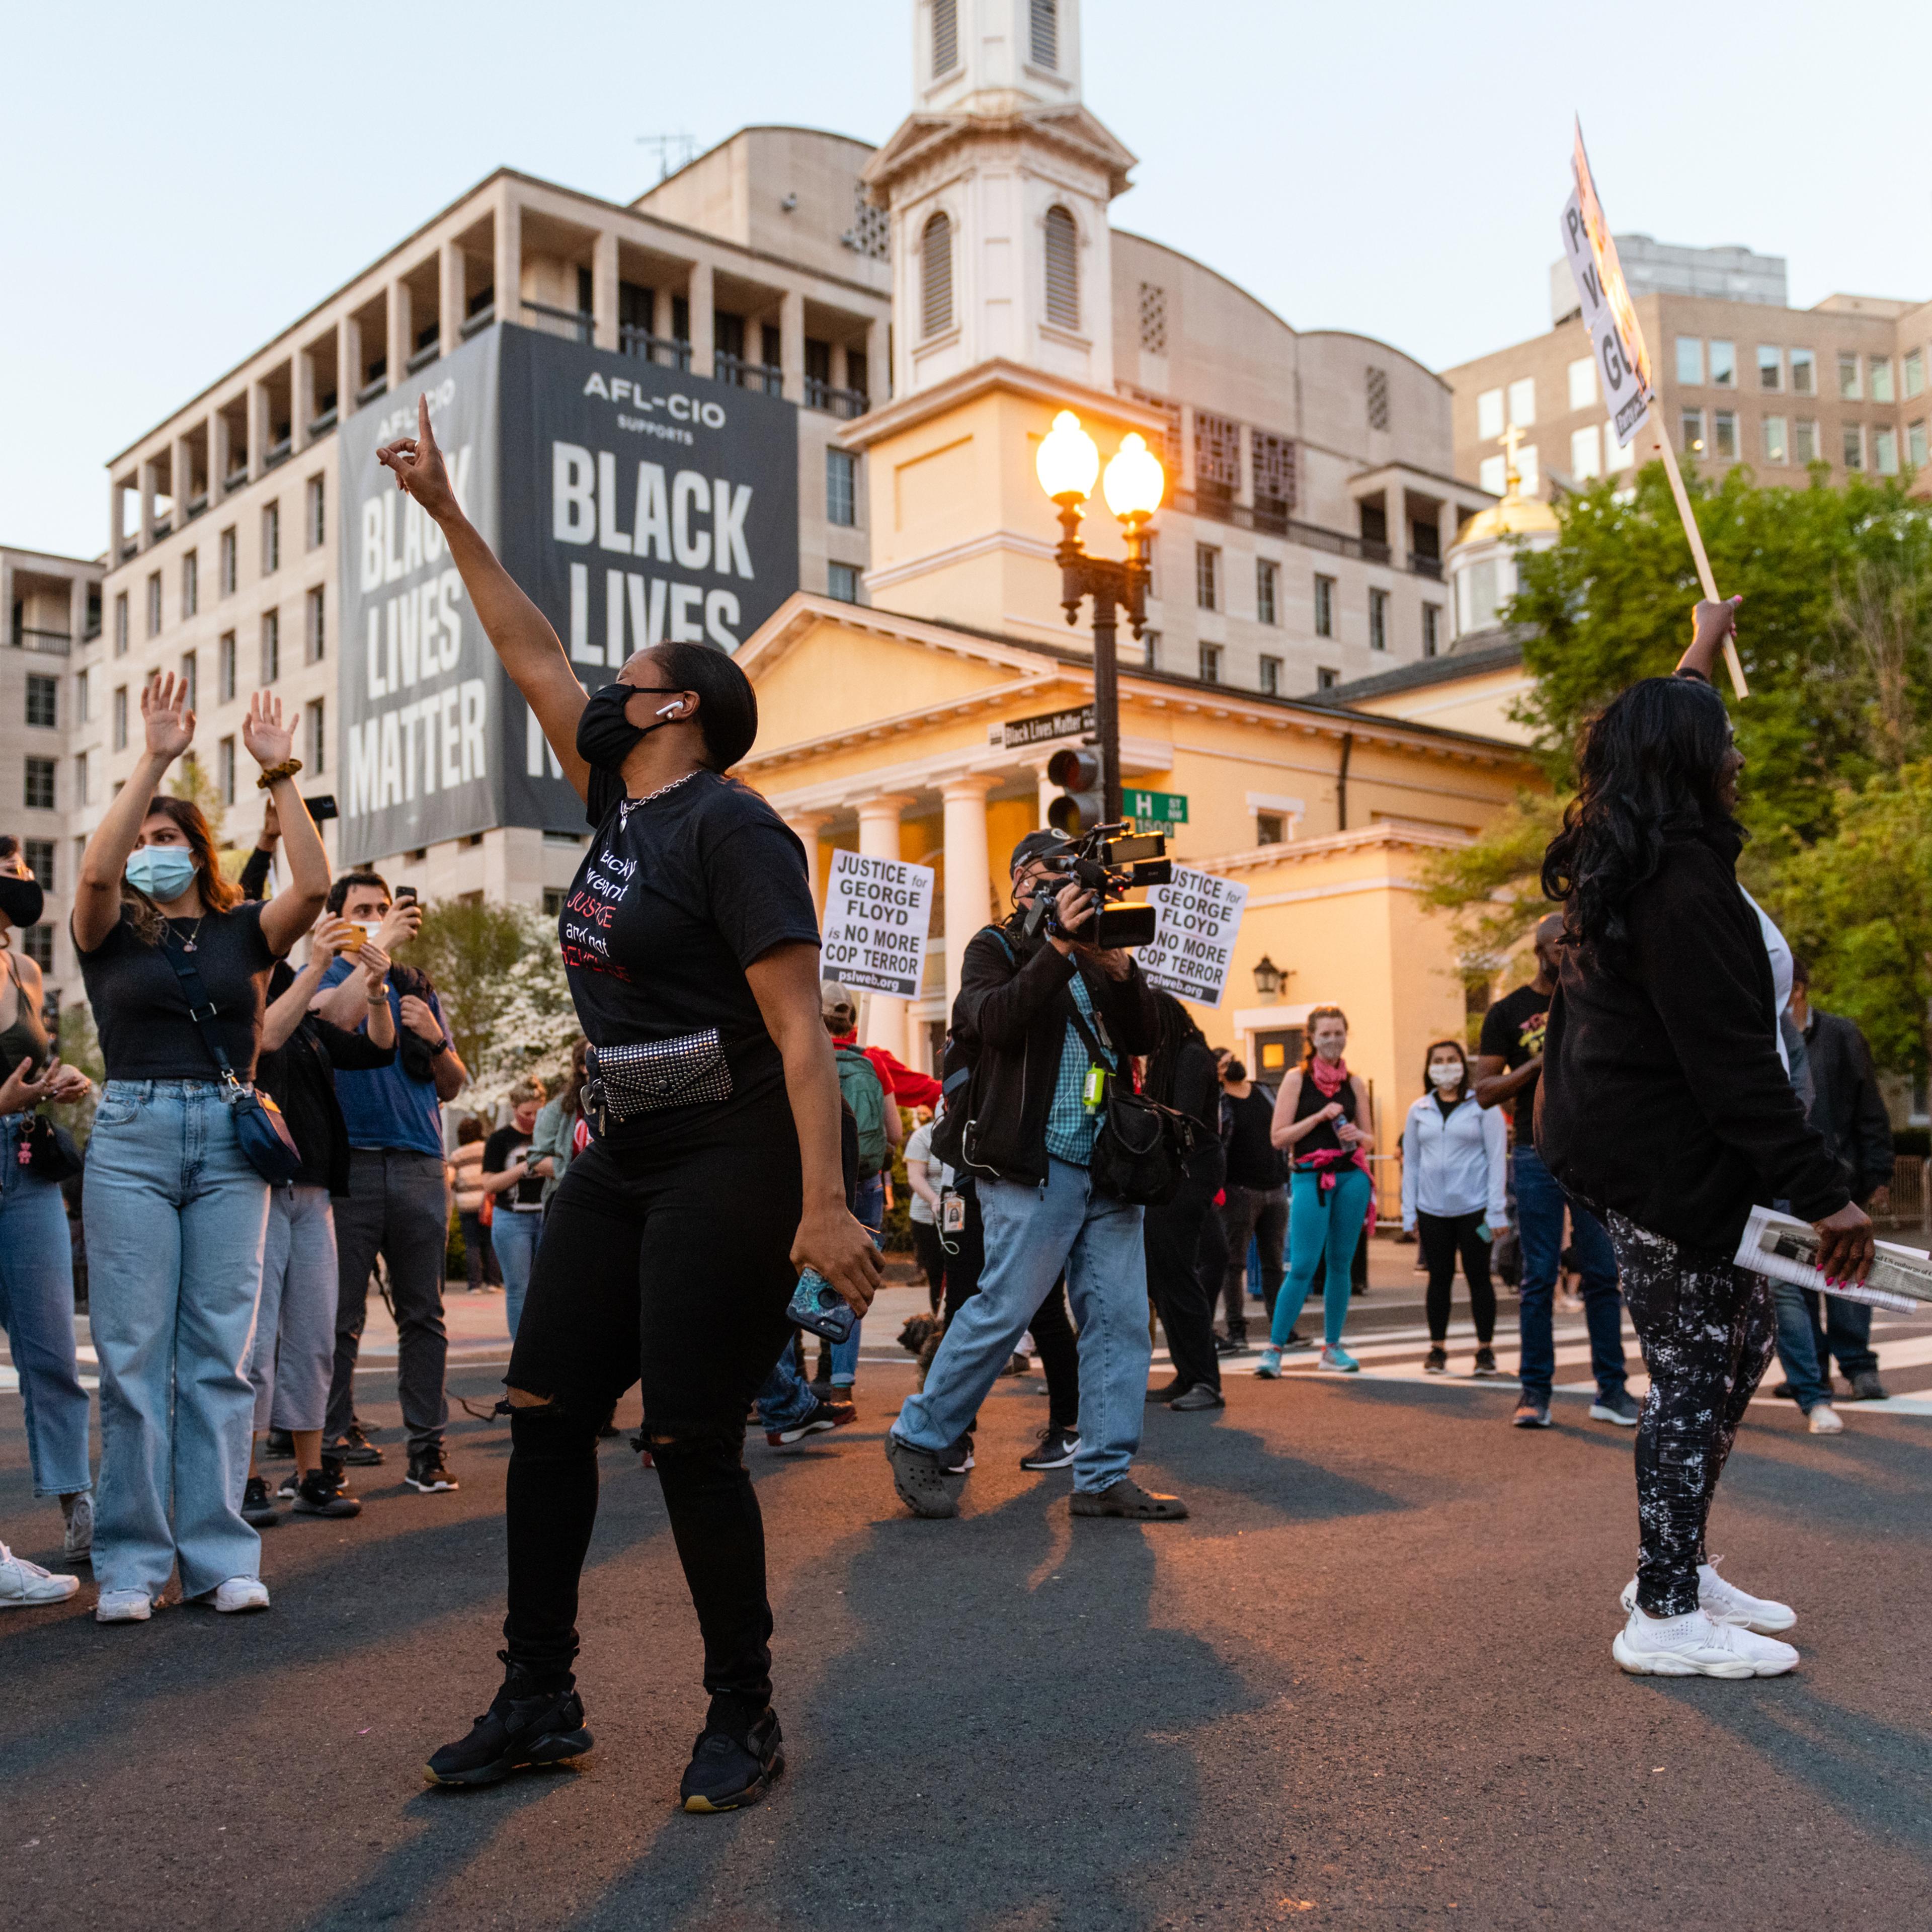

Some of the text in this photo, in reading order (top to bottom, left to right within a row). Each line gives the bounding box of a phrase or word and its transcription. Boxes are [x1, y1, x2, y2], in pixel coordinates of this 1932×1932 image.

[583, 371, 727, 429] AFL-CIO
[616, 413, 694, 446] SUPPORTS
[552, 439, 755, 581] BLACK
[570, 561, 741, 670] LIVES
[368, 567, 462, 701] LIVES
[1006, 723, 1029, 745] Black
[1029, 720, 1053, 740] Lives
[1053, 713, 1081, 735] Matter
[349, 678, 487, 820] MATTER
[1136, 793, 1181, 817] H ST
[1167, 809, 1183, 820] NW
[1138, 819, 1173, 837] 1500
[838, 856, 928, 888] JUSTICE for
[1170, 868, 1242, 904] USTICE for
[840, 879, 921, 908] GEORGE
[1158, 888, 1233, 922] GEORGE
[847, 900, 909, 926] FLOYD
[1162, 908, 1219, 937] FLOYD
[589, 935, 610, 958] not
[828, 924, 920, 953] is NO MORE
[1156, 931, 1228, 964] NO MORE
[826, 943, 918, 975] COP TERROR
[1138, 946, 1223, 985] COP TERROR
